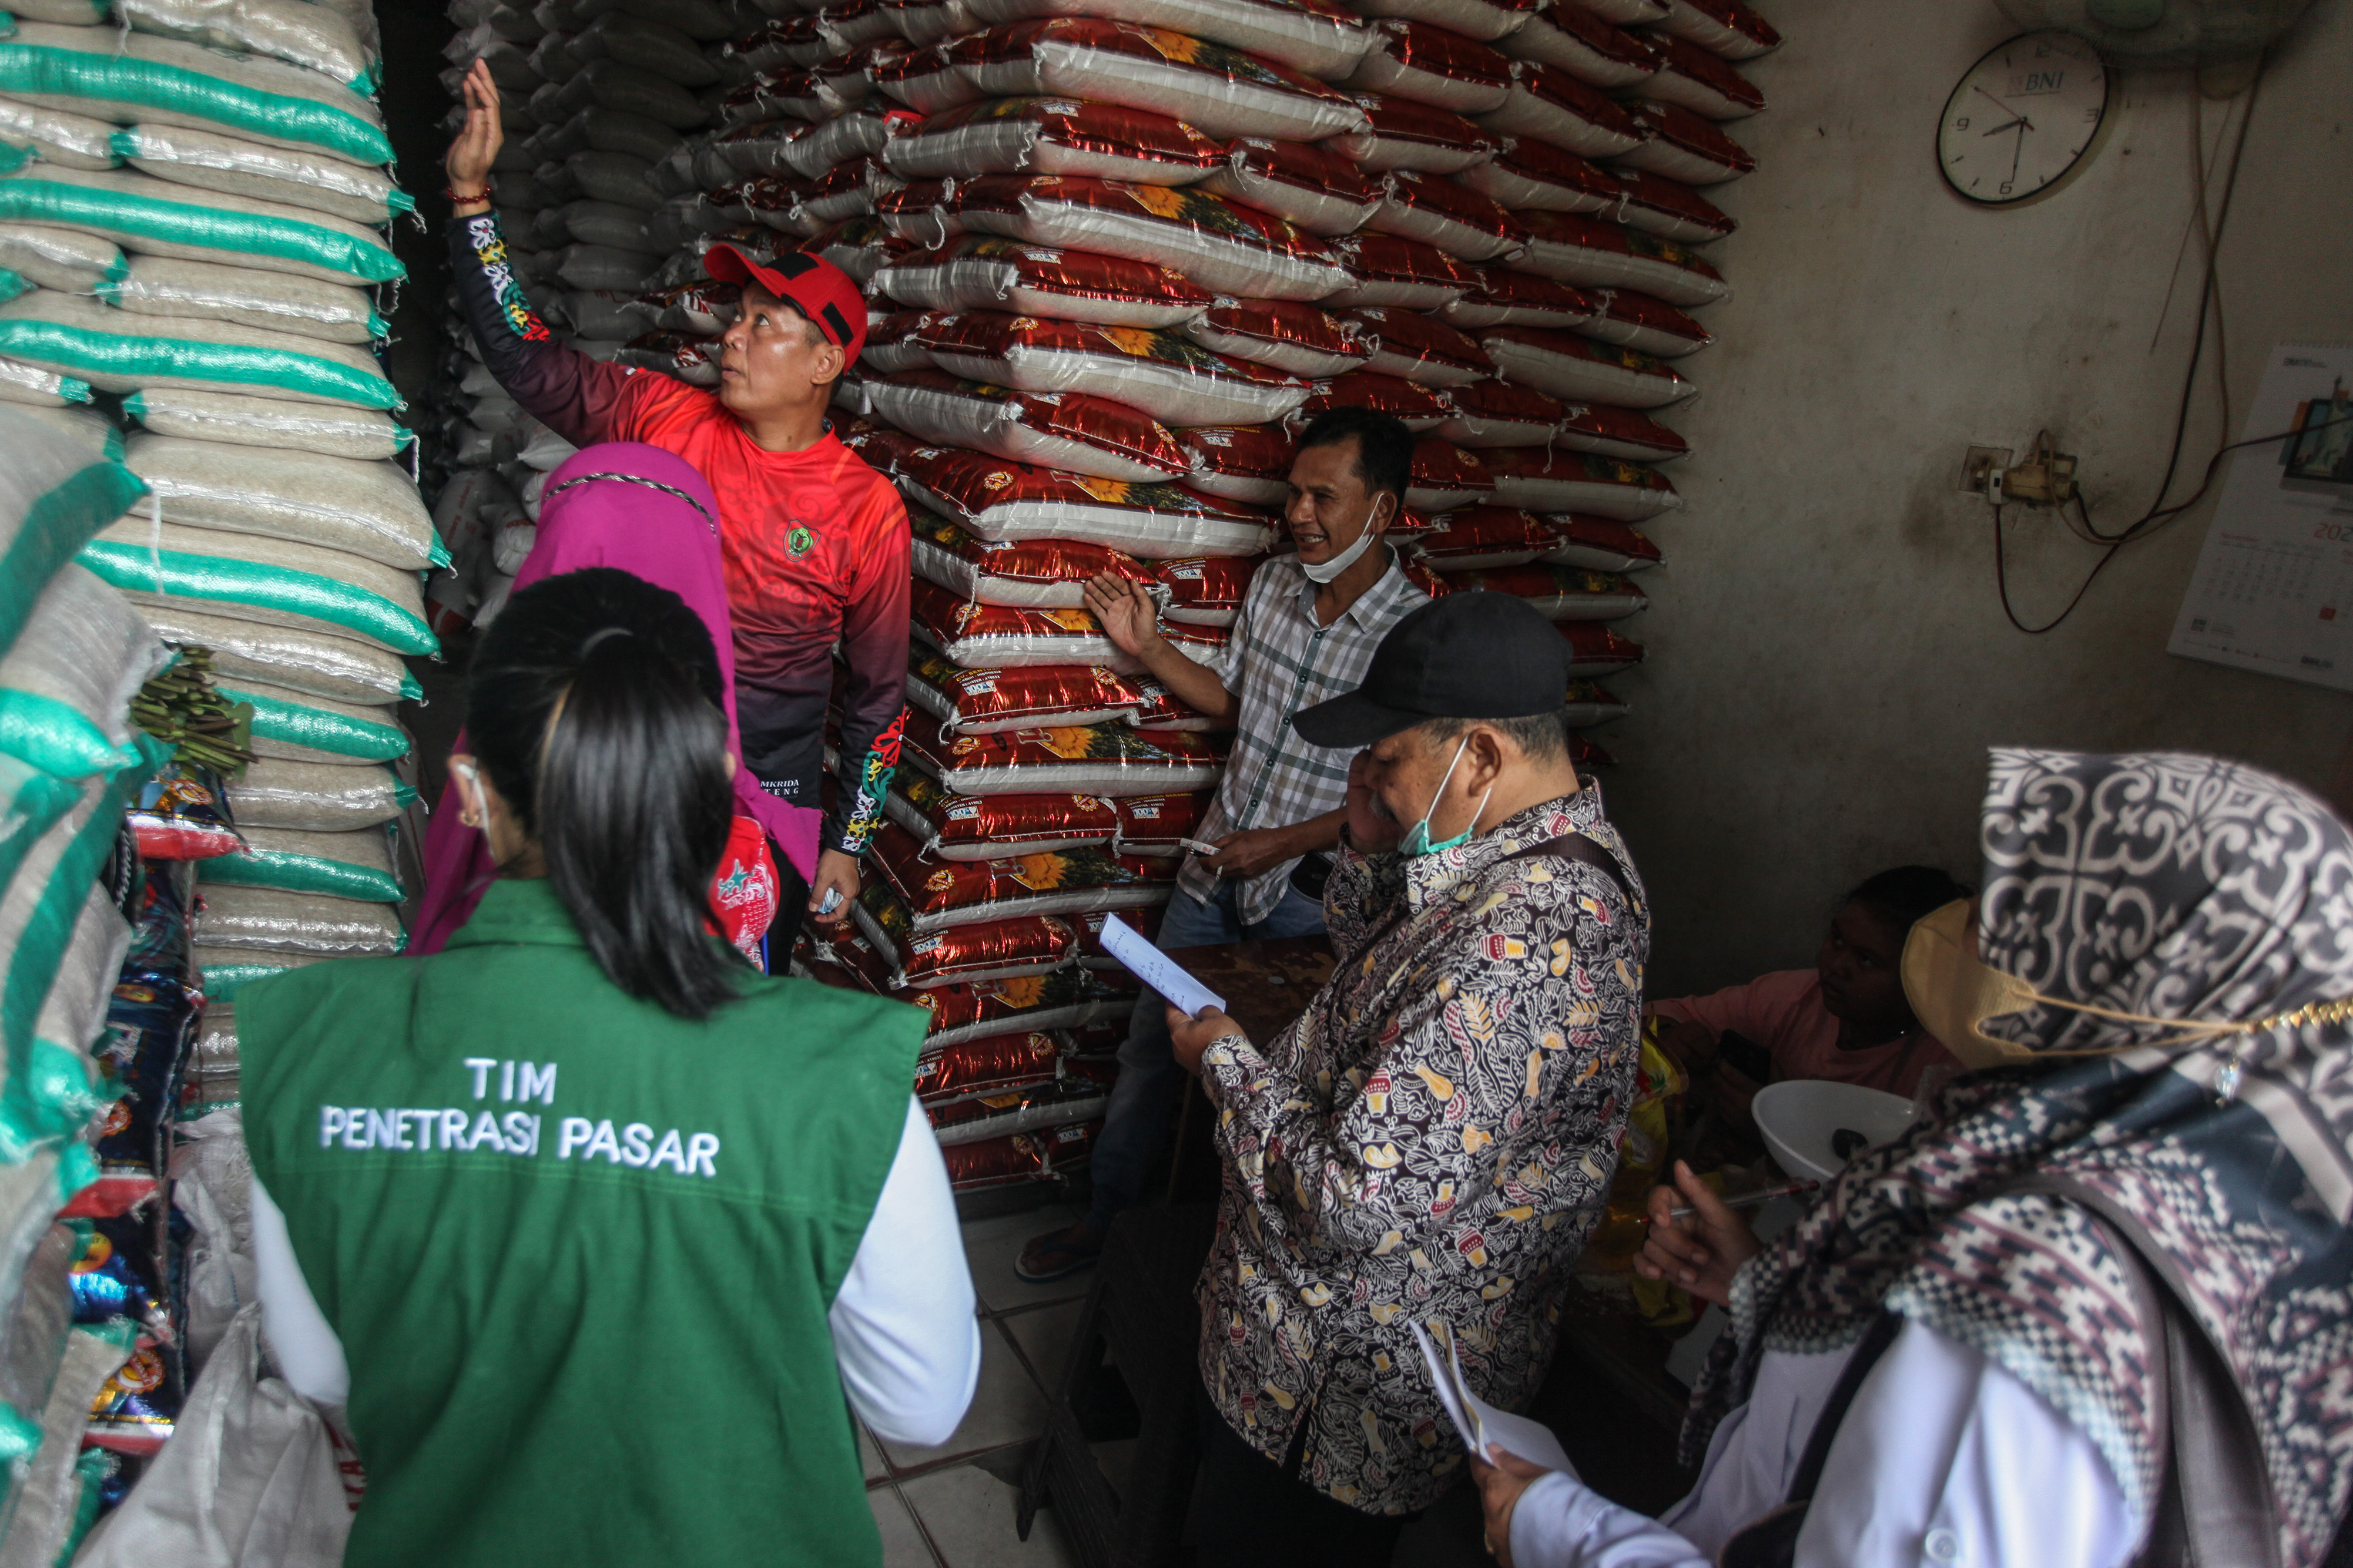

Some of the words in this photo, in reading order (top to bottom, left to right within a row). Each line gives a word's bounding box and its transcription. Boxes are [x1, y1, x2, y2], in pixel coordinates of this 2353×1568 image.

[2026, 72, 2063, 91] BNI
[1958, 118, 1969, 130] 9
[2000, 182, 2013, 194] 6
[961, 679, 982, 687] REGISTER
[464, 1057, 557, 1104] TIM
[321, 1105, 541, 1156] PENETRASI
[559, 1117, 720, 1176] PASAR
